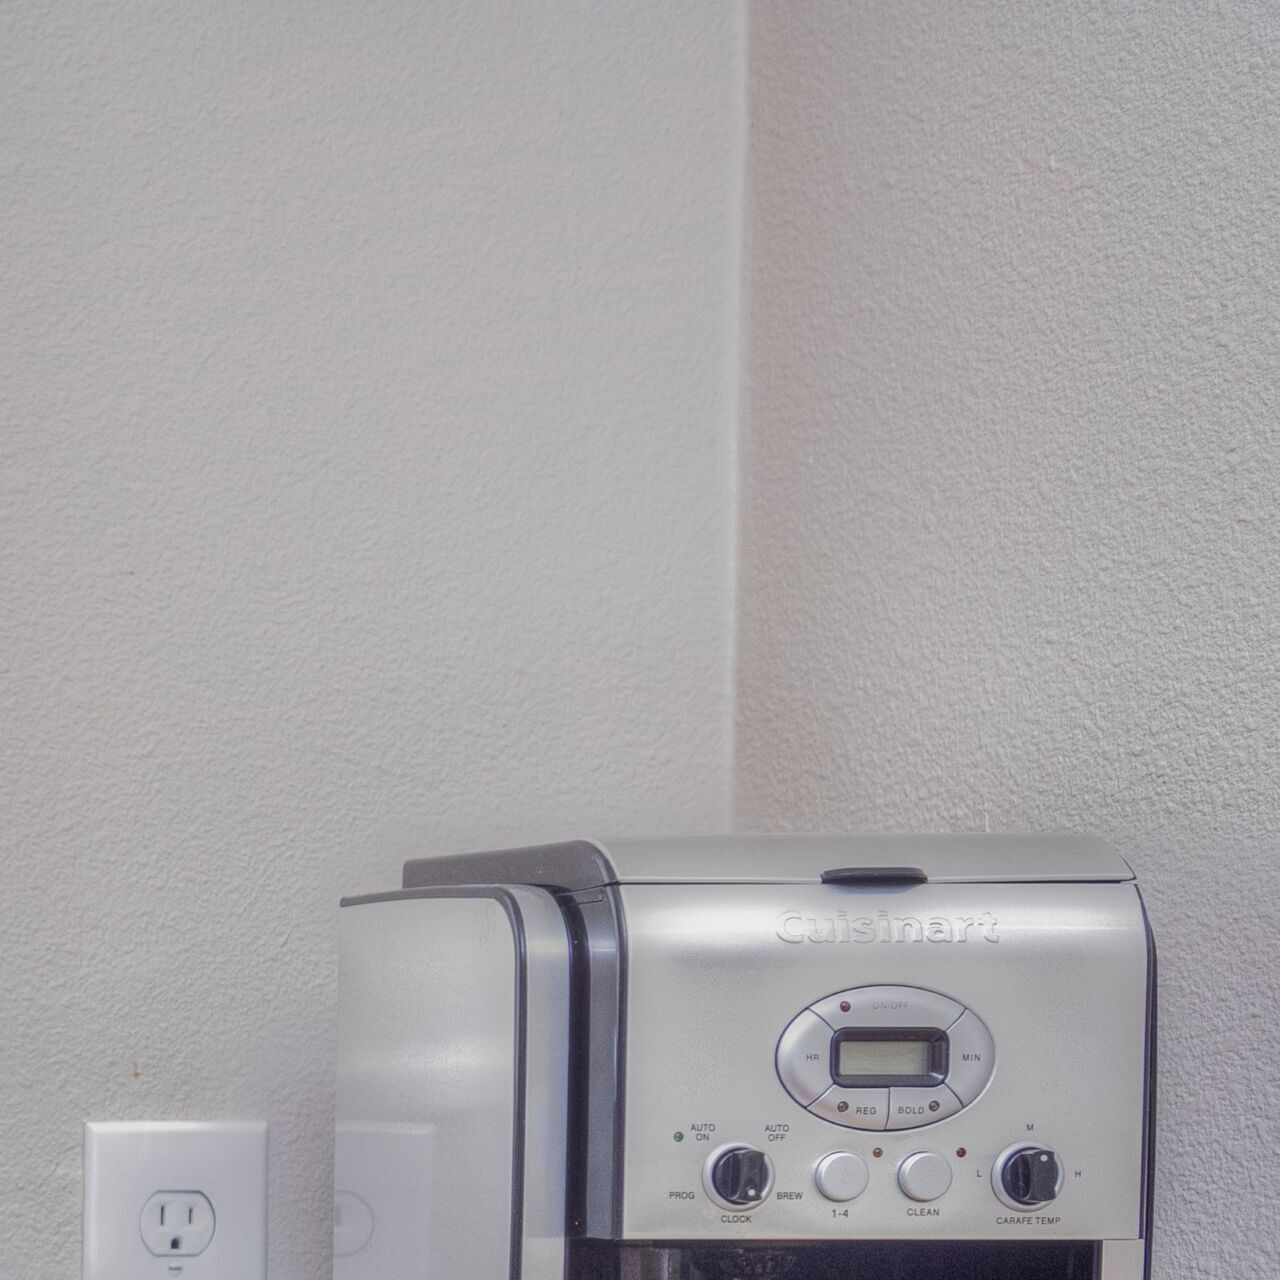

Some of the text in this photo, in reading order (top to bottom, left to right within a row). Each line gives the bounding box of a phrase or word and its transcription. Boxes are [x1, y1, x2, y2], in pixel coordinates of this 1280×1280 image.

[775, 909, 1001, 945] Cuisinart
[872, 1002, 910, 1010] ON/OFF
[806, 1053, 820, 1062] HR
[962, 1053, 981, 1062] MIN
[856, 1106, 877, 1115] REG
[898, 1106, 925, 1115] BOLD
[690, 1124, 716, 1132] AUTO
[765, 1124, 790, 1133] AUTO
[1026, 1123, 1034, 1131] M
[695, 1133, 710, 1141] ON
[768, 1134, 786, 1142] OFF
[976, 1170, 983, 1178] L
[1074, 1170, 1082, 1178] H
[669, 1191, 695, 1200] PROG
[777, 1192, 804, 1200] BREW
[831, 1209, 849, 1219] 1-4
[906, 1208, 940, 1217] CLEAN
[720, 1215, 752, 1224] CLOCK
[996, 1216, 1061, 1225] CARAFE TEMP
